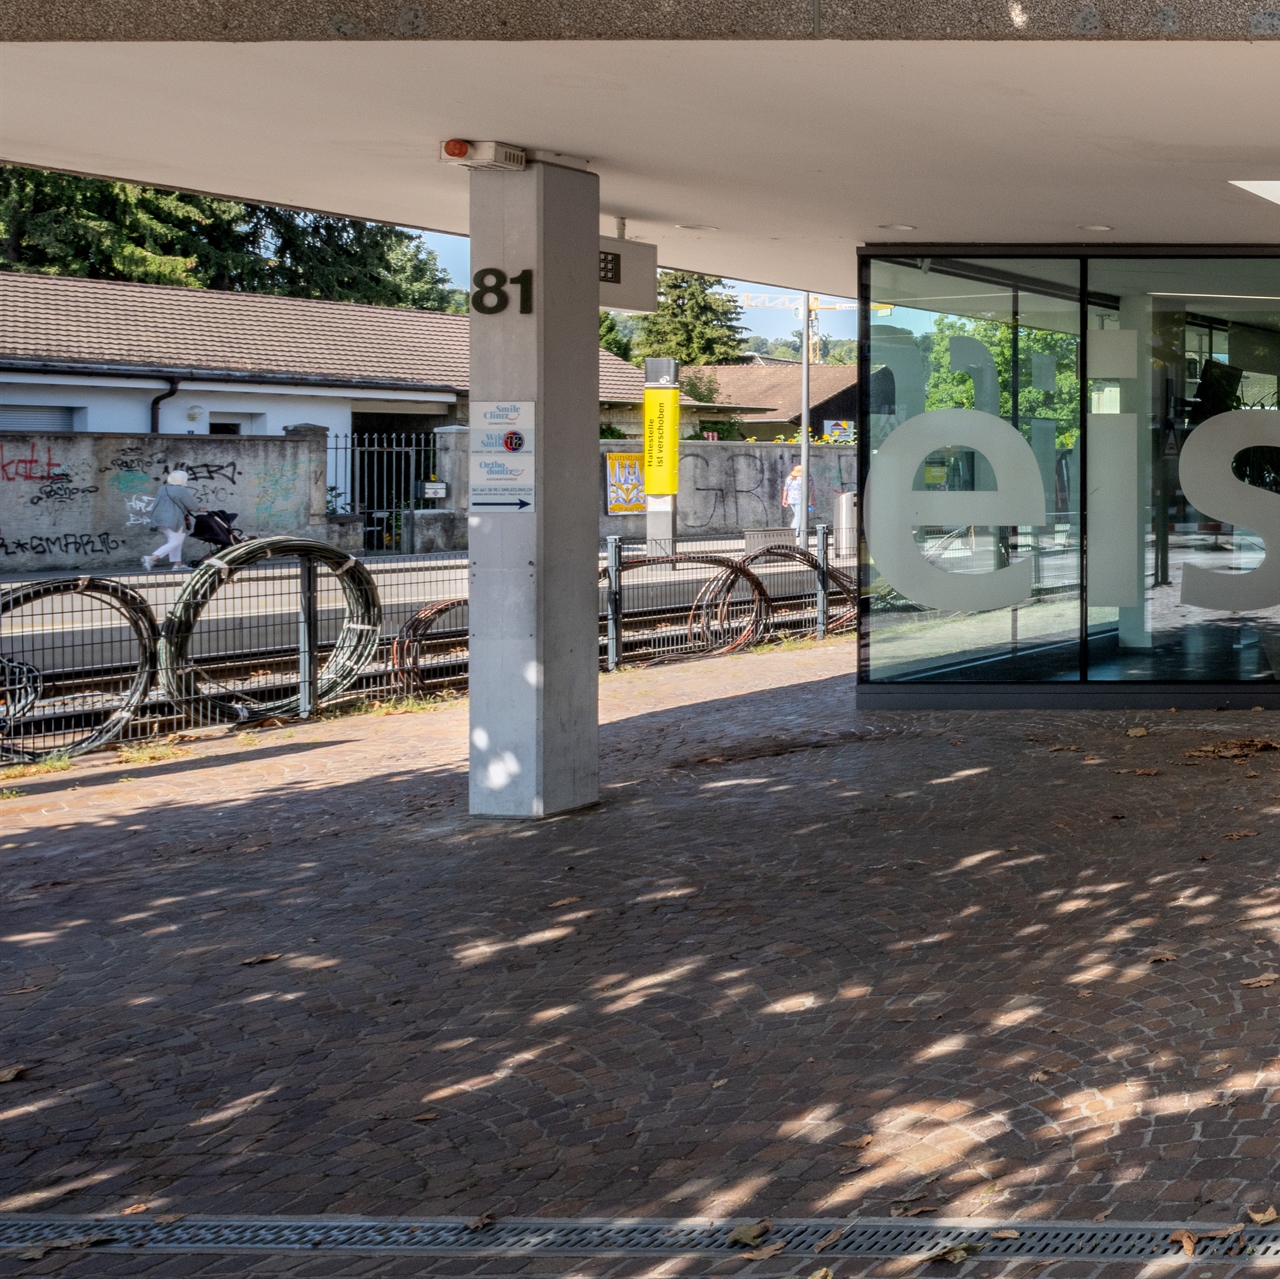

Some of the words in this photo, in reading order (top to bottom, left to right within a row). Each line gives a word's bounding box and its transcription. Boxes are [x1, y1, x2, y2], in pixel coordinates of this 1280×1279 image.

[471, 268, 533, 315] 81
[496, 404, 521, 413] Smile
[647, 418, 655, 467] Haltestelle
[657, 402, 665, 454] verschoben
[479, 460, 506, 470] Ortho
[655, 456, 664, 467] ist
